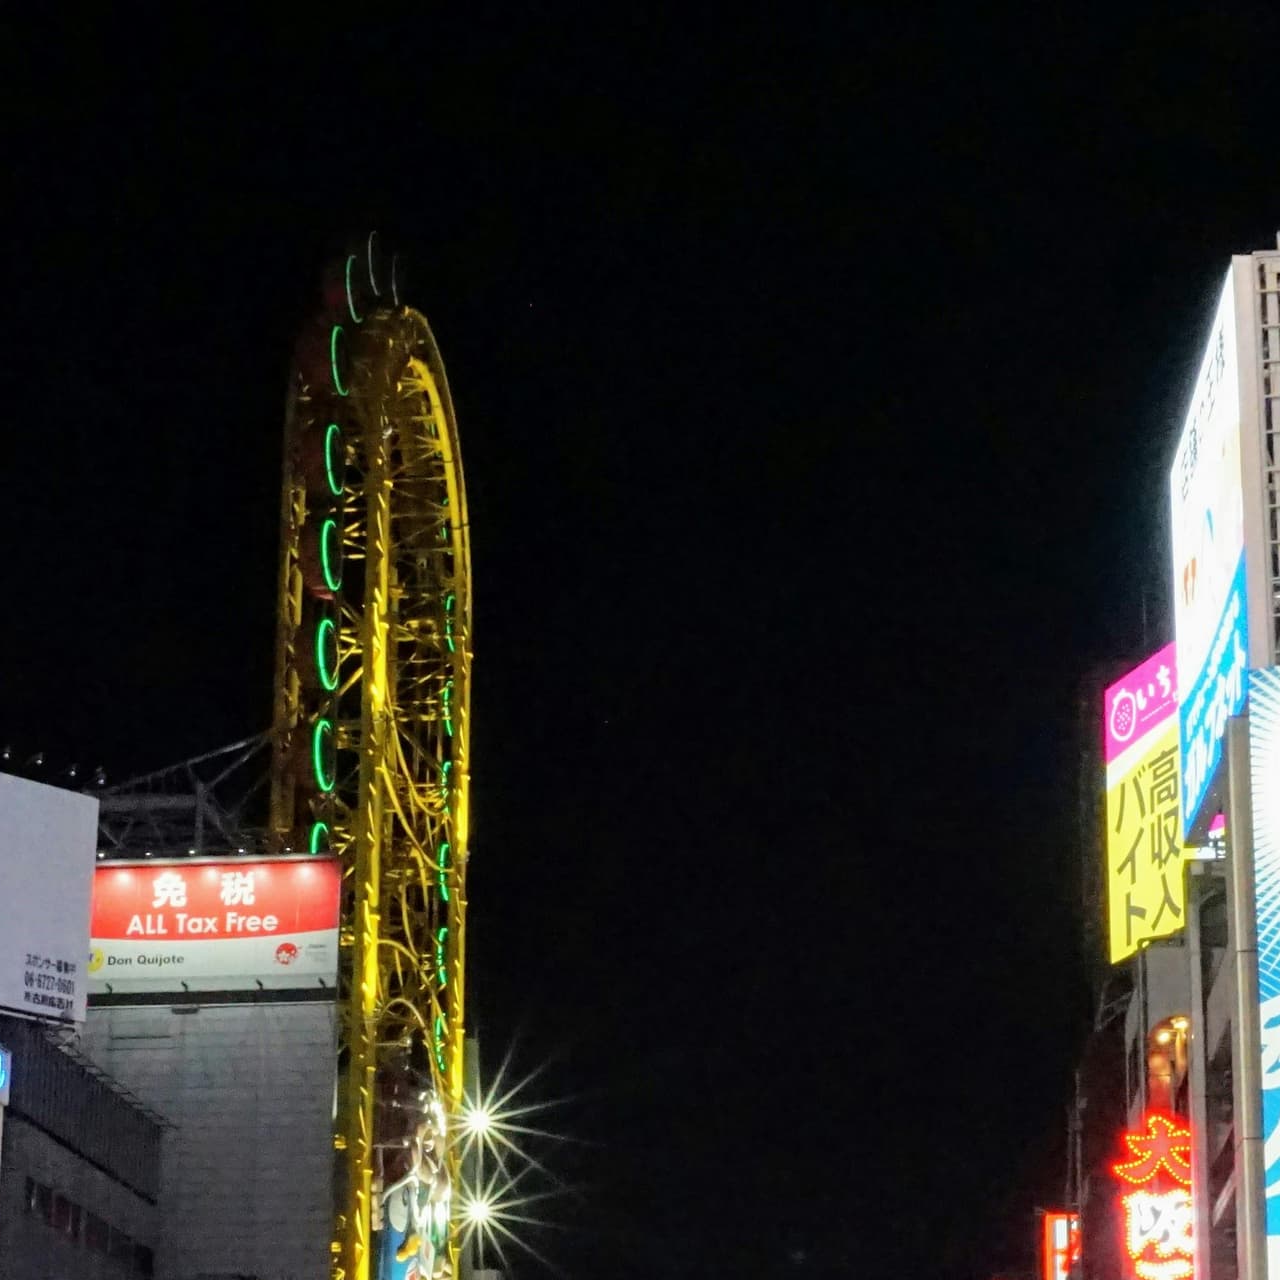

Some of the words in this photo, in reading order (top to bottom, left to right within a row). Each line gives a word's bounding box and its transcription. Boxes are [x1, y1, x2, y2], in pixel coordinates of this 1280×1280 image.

[1115, 767, 1148, 947] バイト
[151, 871, 256, 909] 免税
[126, 914, 168, 936] ALL
[175, 913, 218, 934] Tax
[225, 911, 279, 933] Free
[107, 955, 133, 967] Don
[136, 953, 185, 967] Quijote
